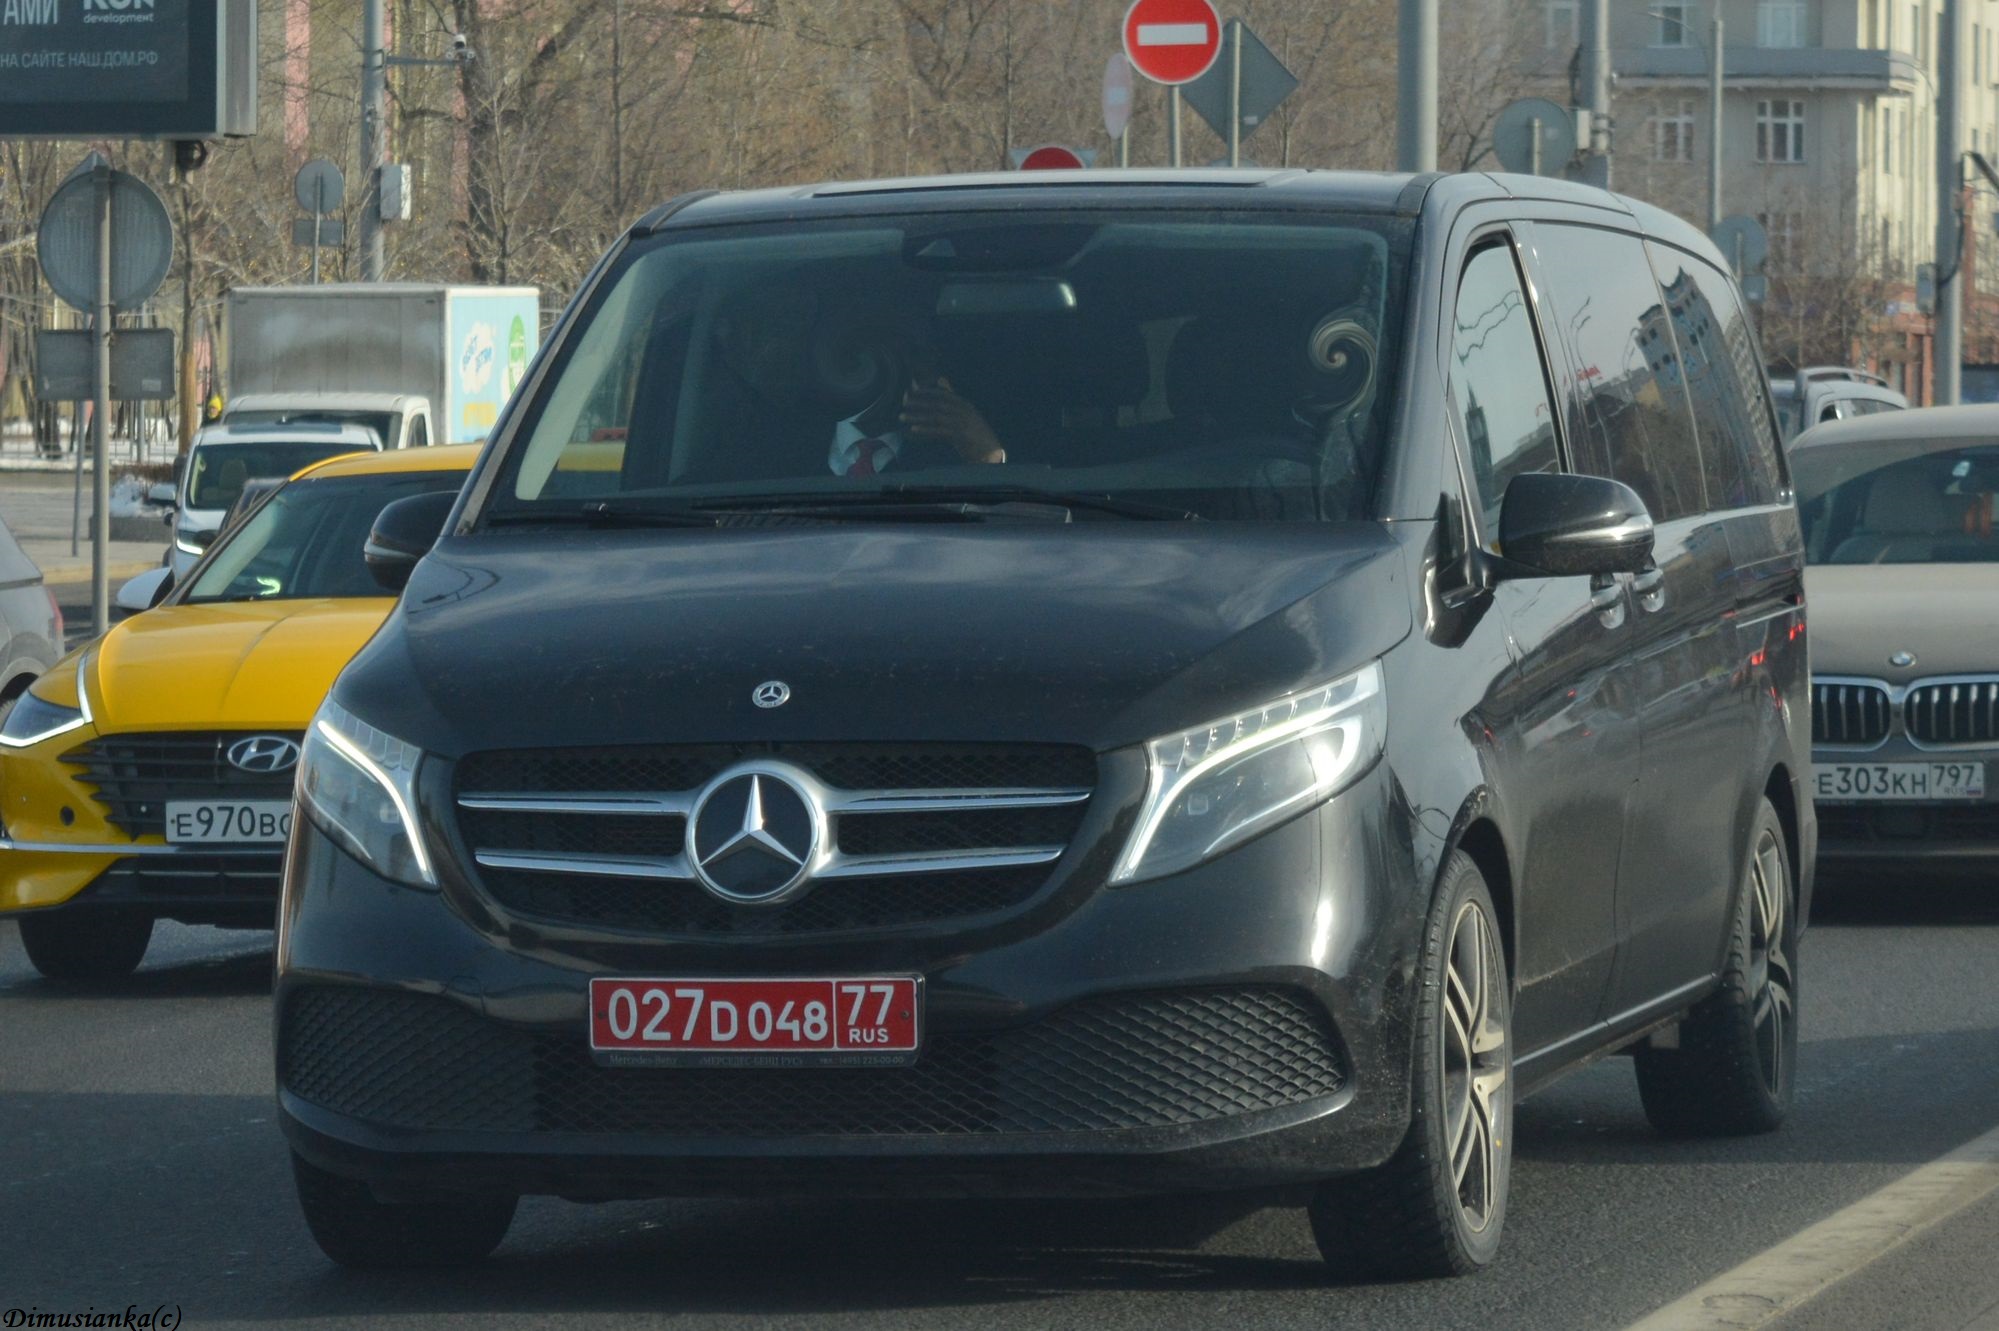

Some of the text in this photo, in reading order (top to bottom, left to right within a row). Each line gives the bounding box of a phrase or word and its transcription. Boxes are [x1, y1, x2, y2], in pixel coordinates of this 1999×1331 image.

[83, 13, 154, 24] development
[0, 50, 158, 69] НА САЙТЕ НАШ.ДОМ.РФ
[1933, 765, 1975, 787] 797
[841, 985, 894, 1025] 77
[849, 1028, 889, 1043] RUS
